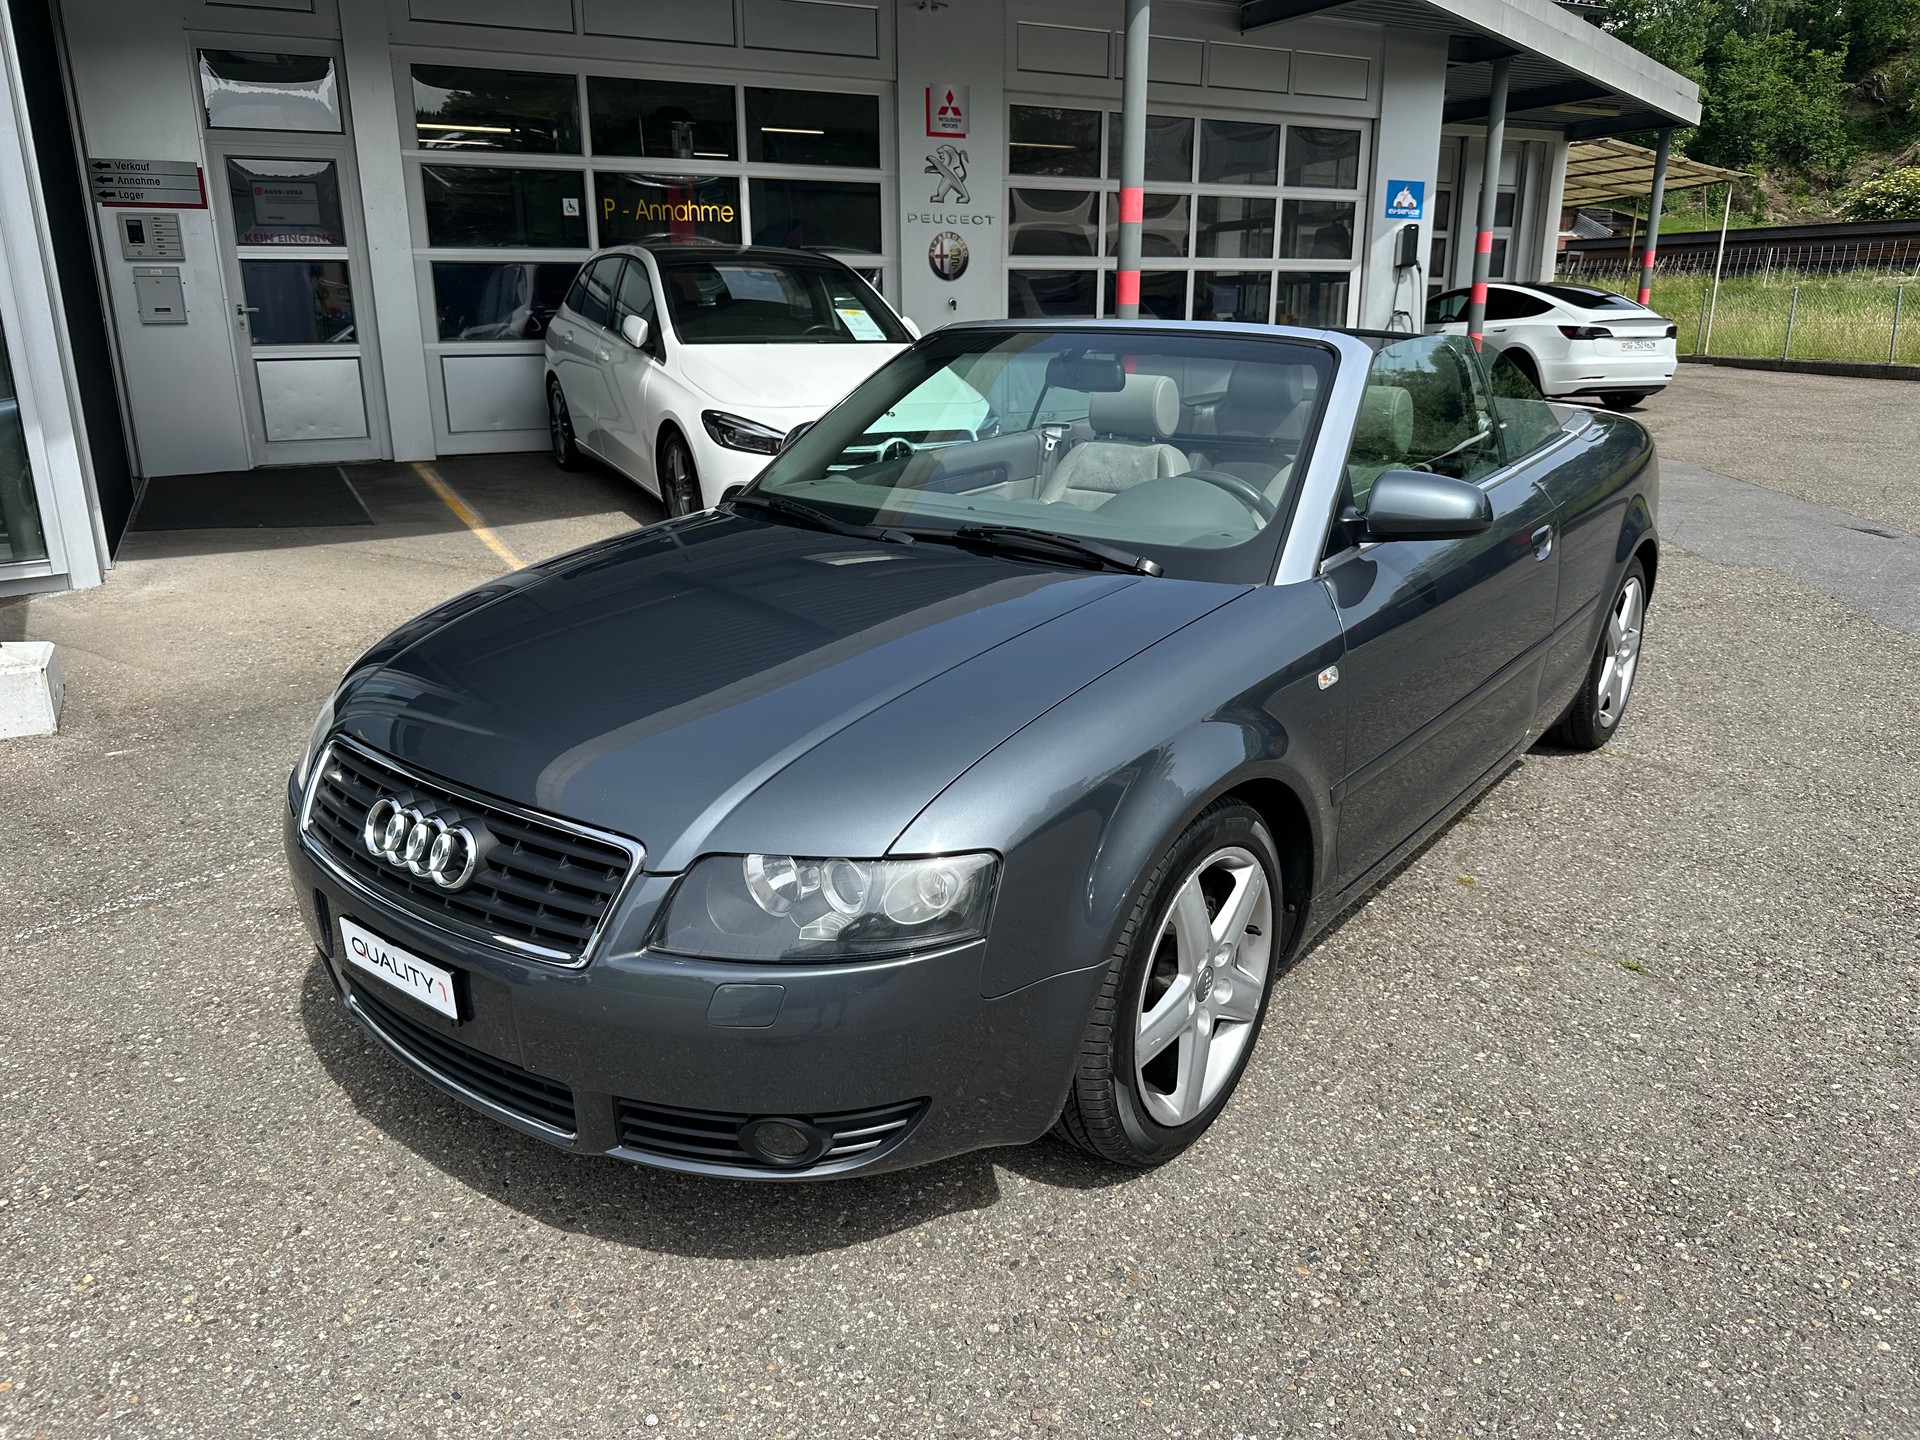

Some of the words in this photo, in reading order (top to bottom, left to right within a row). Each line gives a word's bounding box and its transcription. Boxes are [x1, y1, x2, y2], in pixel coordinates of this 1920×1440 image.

[114, 161, 150, 171] Verkauf
[117, 176, 161, 186] Annahme
[118, 190, 145, 201] Lager
[604, 198, 615, 220] P
[635, 199, 735, 223] Annahme
[907, 213, 995, 225] PEUGEOT
[244, 233, 273, 243] KEIN
[277, 234, 337, 244] EINGANG
